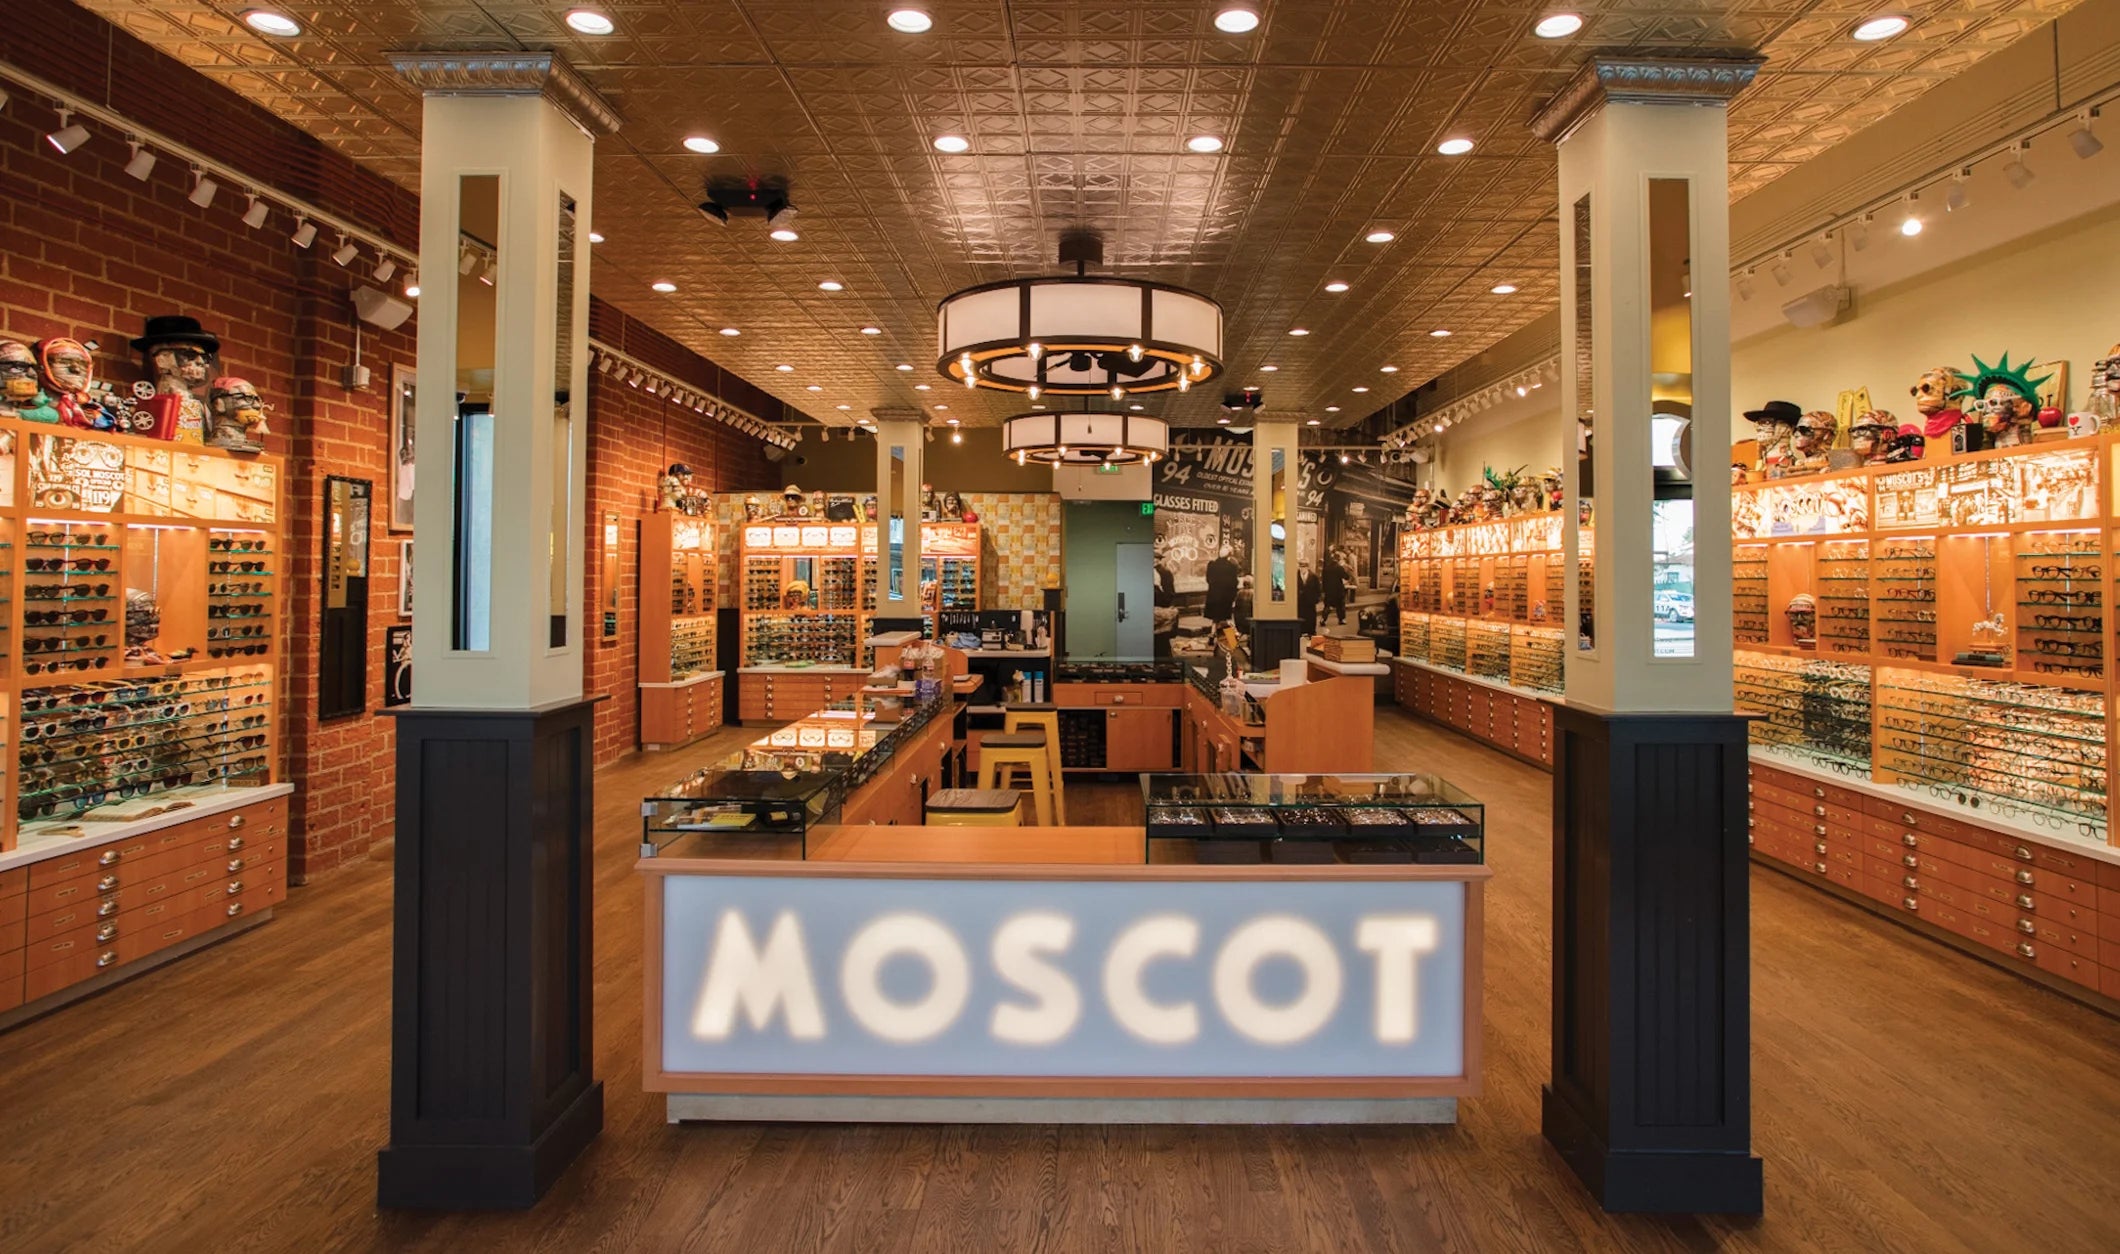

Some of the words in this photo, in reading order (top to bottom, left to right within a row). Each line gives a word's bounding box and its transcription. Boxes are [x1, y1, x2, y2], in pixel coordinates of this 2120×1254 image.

[1161, 462, 1192, 485] 94
[1153, 494, 1191, 510] GLASSES
[1192, 498, 1219, 512] FITTED
[1306, 490, 1324, 506] 94
[691, 907, 1438, 1045] MOSCOT
